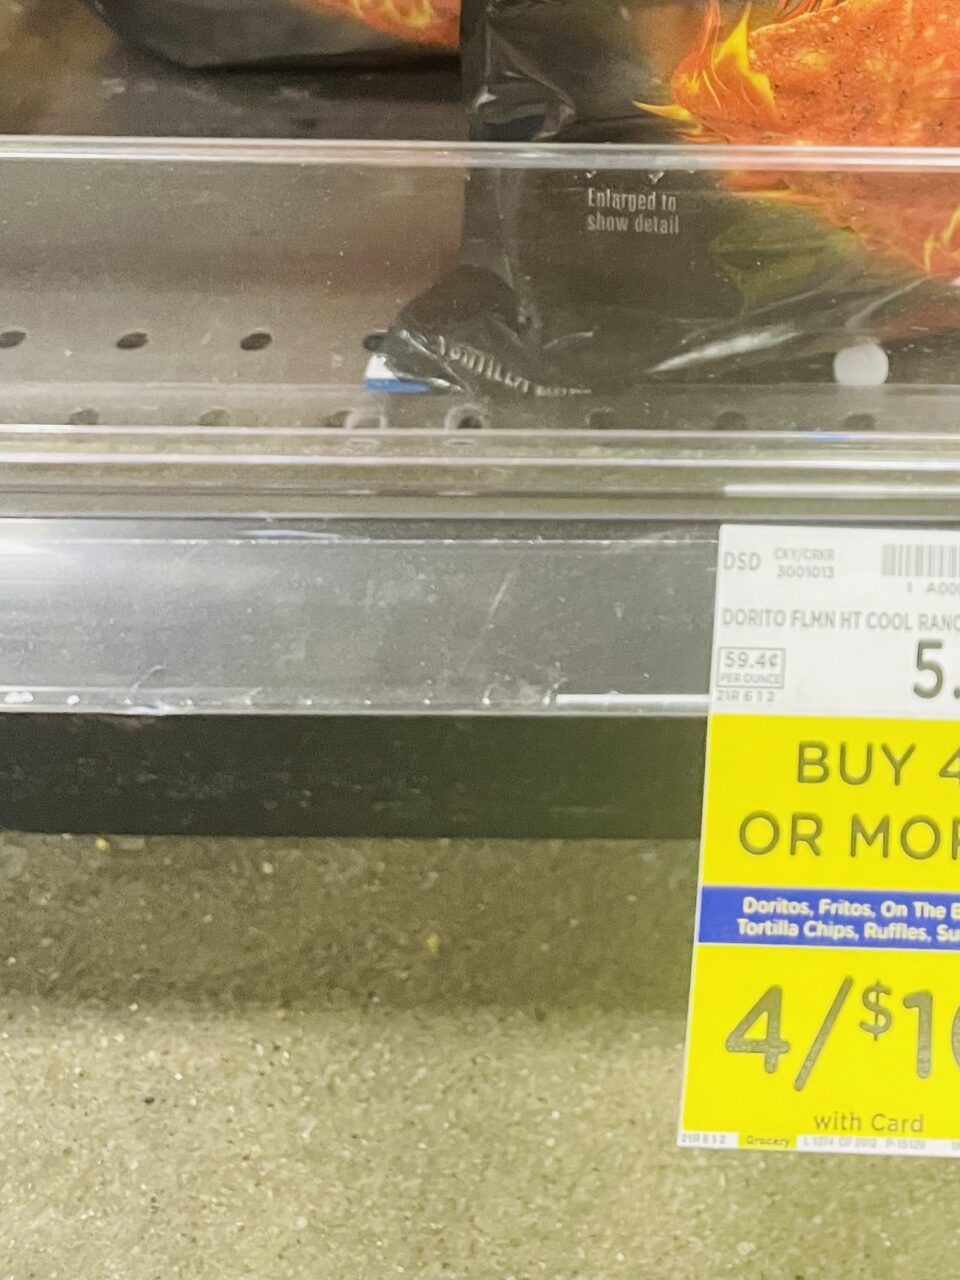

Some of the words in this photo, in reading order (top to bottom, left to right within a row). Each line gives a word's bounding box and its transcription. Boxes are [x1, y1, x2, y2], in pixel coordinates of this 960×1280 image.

[588, 187, 656, 212] Enlarged
[662, 194, 677, 212] to
[587, 211, 629, 231] show
[635, 213, 679, 235] detail
[723, 551, 762, 571] DSD
[722, 608, 787, 627] DORITO
[790, 610, 836, 629] FLMN
[840, 612, 862, 629] HT
[866, 612, 913, 631] COOL
[797, 740, 916, 787] BUY
[739, 810, 823, 857] OR
[743, 896, 814, 916] Doritos,
[819, 899, 876, 918] Fritos,
[880, 901, 908, 917] On
[913, 901, 946, 919] The
[737, 918, 799, 936] Tortilla
[803, 920, 859, 941] Chips,
[864, 923, 932, 943] Ruffles,
[814, 1110, 862, 1131] with
[871, 1113, 924, 1133] Card
[746, 1135, 790, 1148] Grocery
